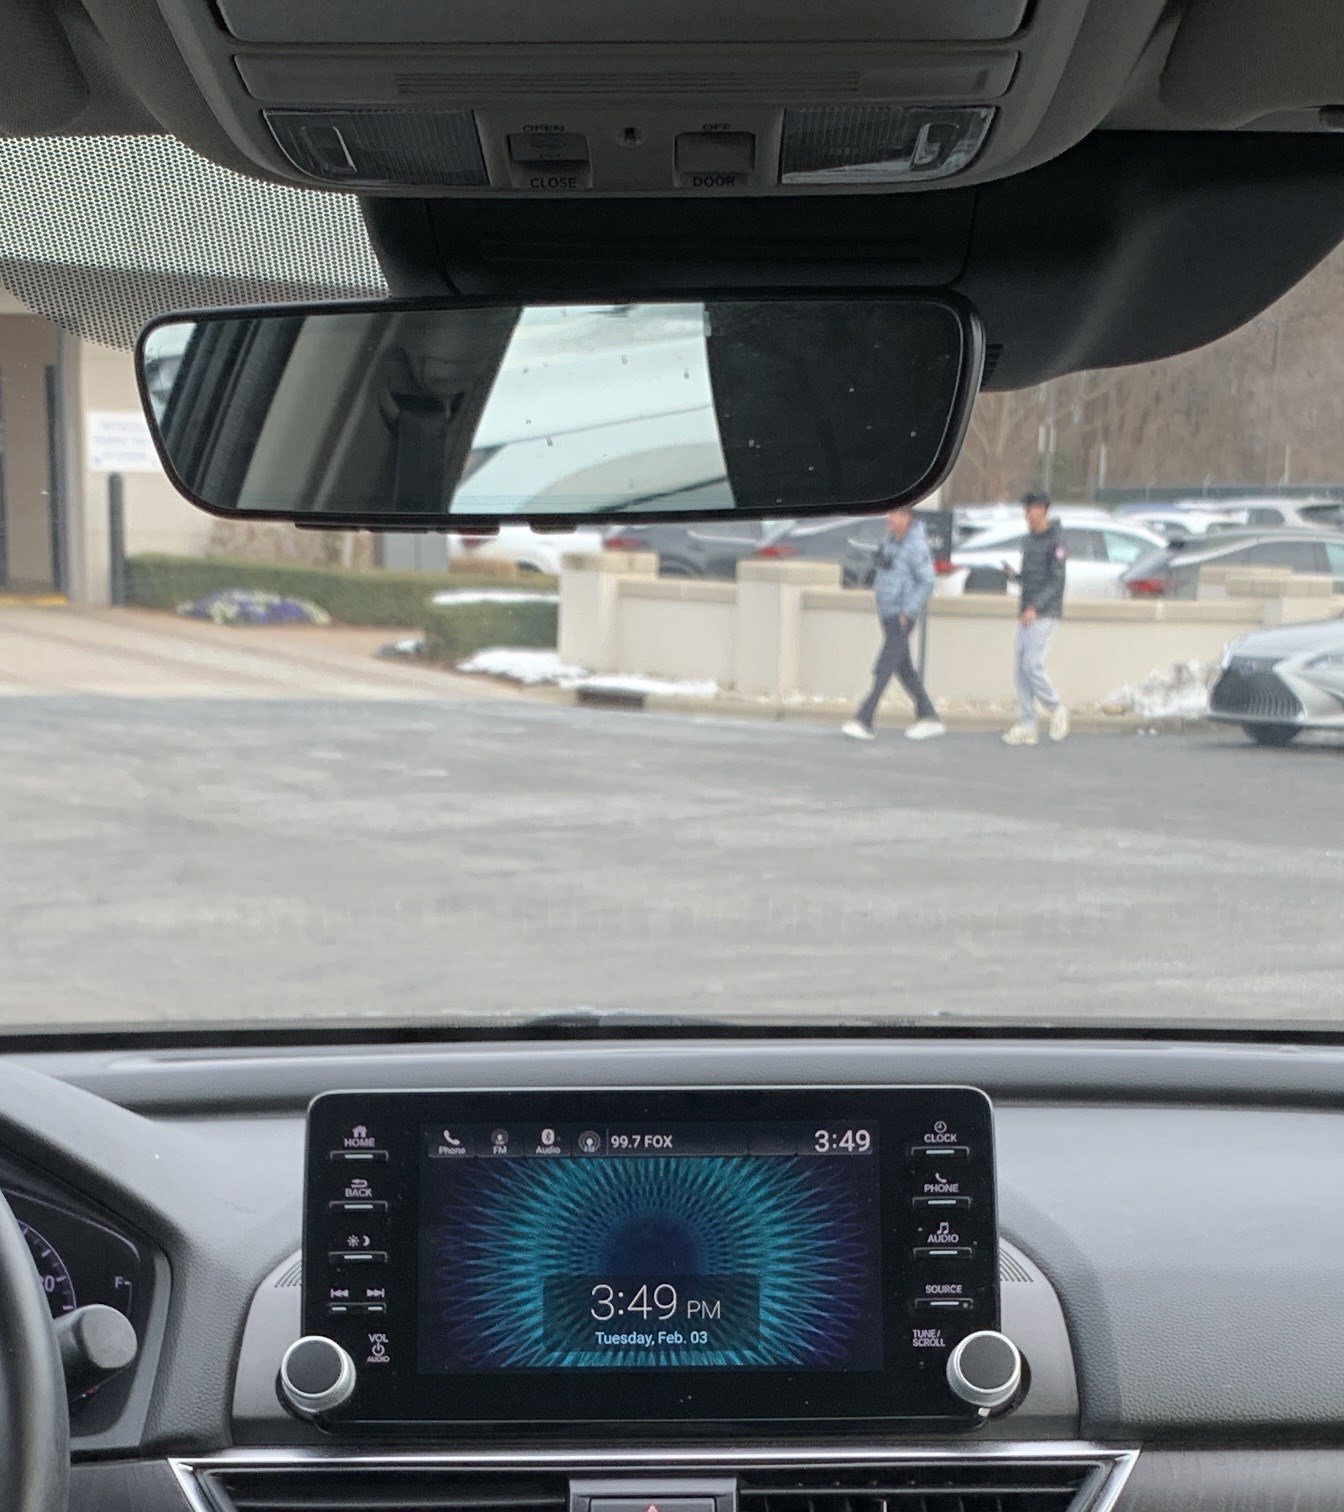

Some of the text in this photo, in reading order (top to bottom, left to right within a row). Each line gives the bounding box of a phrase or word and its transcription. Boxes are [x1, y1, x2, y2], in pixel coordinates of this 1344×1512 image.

[530, 177, 577, 189] CLOSE
[693, 176, 737, 187] DOOR
[344, 1138, 375, 1147] HOME
[611, 1135, 673, 1148] 99.7 FOX
[814, 1129, 871, 1152] 3:49
[924, 1133, 958, 1143] CLOCK
[439, 1145, 466, 1155] Phone
[493, 1146, 507, 1155] FM
[536, 1145, 561, 1155] Audio
[345, 1188, 372, 1197] BACK
[924, 1183, 959, 1193] PHONE
[927, 1233, 960, 1243] AUDIO
[115, 1276, 124, 1290] F
[925, 1284, 963, 1294] SOURCE
[591, 1283, 722, 1321] 3:49 PM
[368, 1333, 388, 1342] VOL
[912, 1329, 941, 1338] TUNE/
[595, 1331, 708, 1347] Tuesday, Feb. 03
[912, 1338, 945, 1347] SCROLL
[367, 1355, 390, 1363] AUDIO
